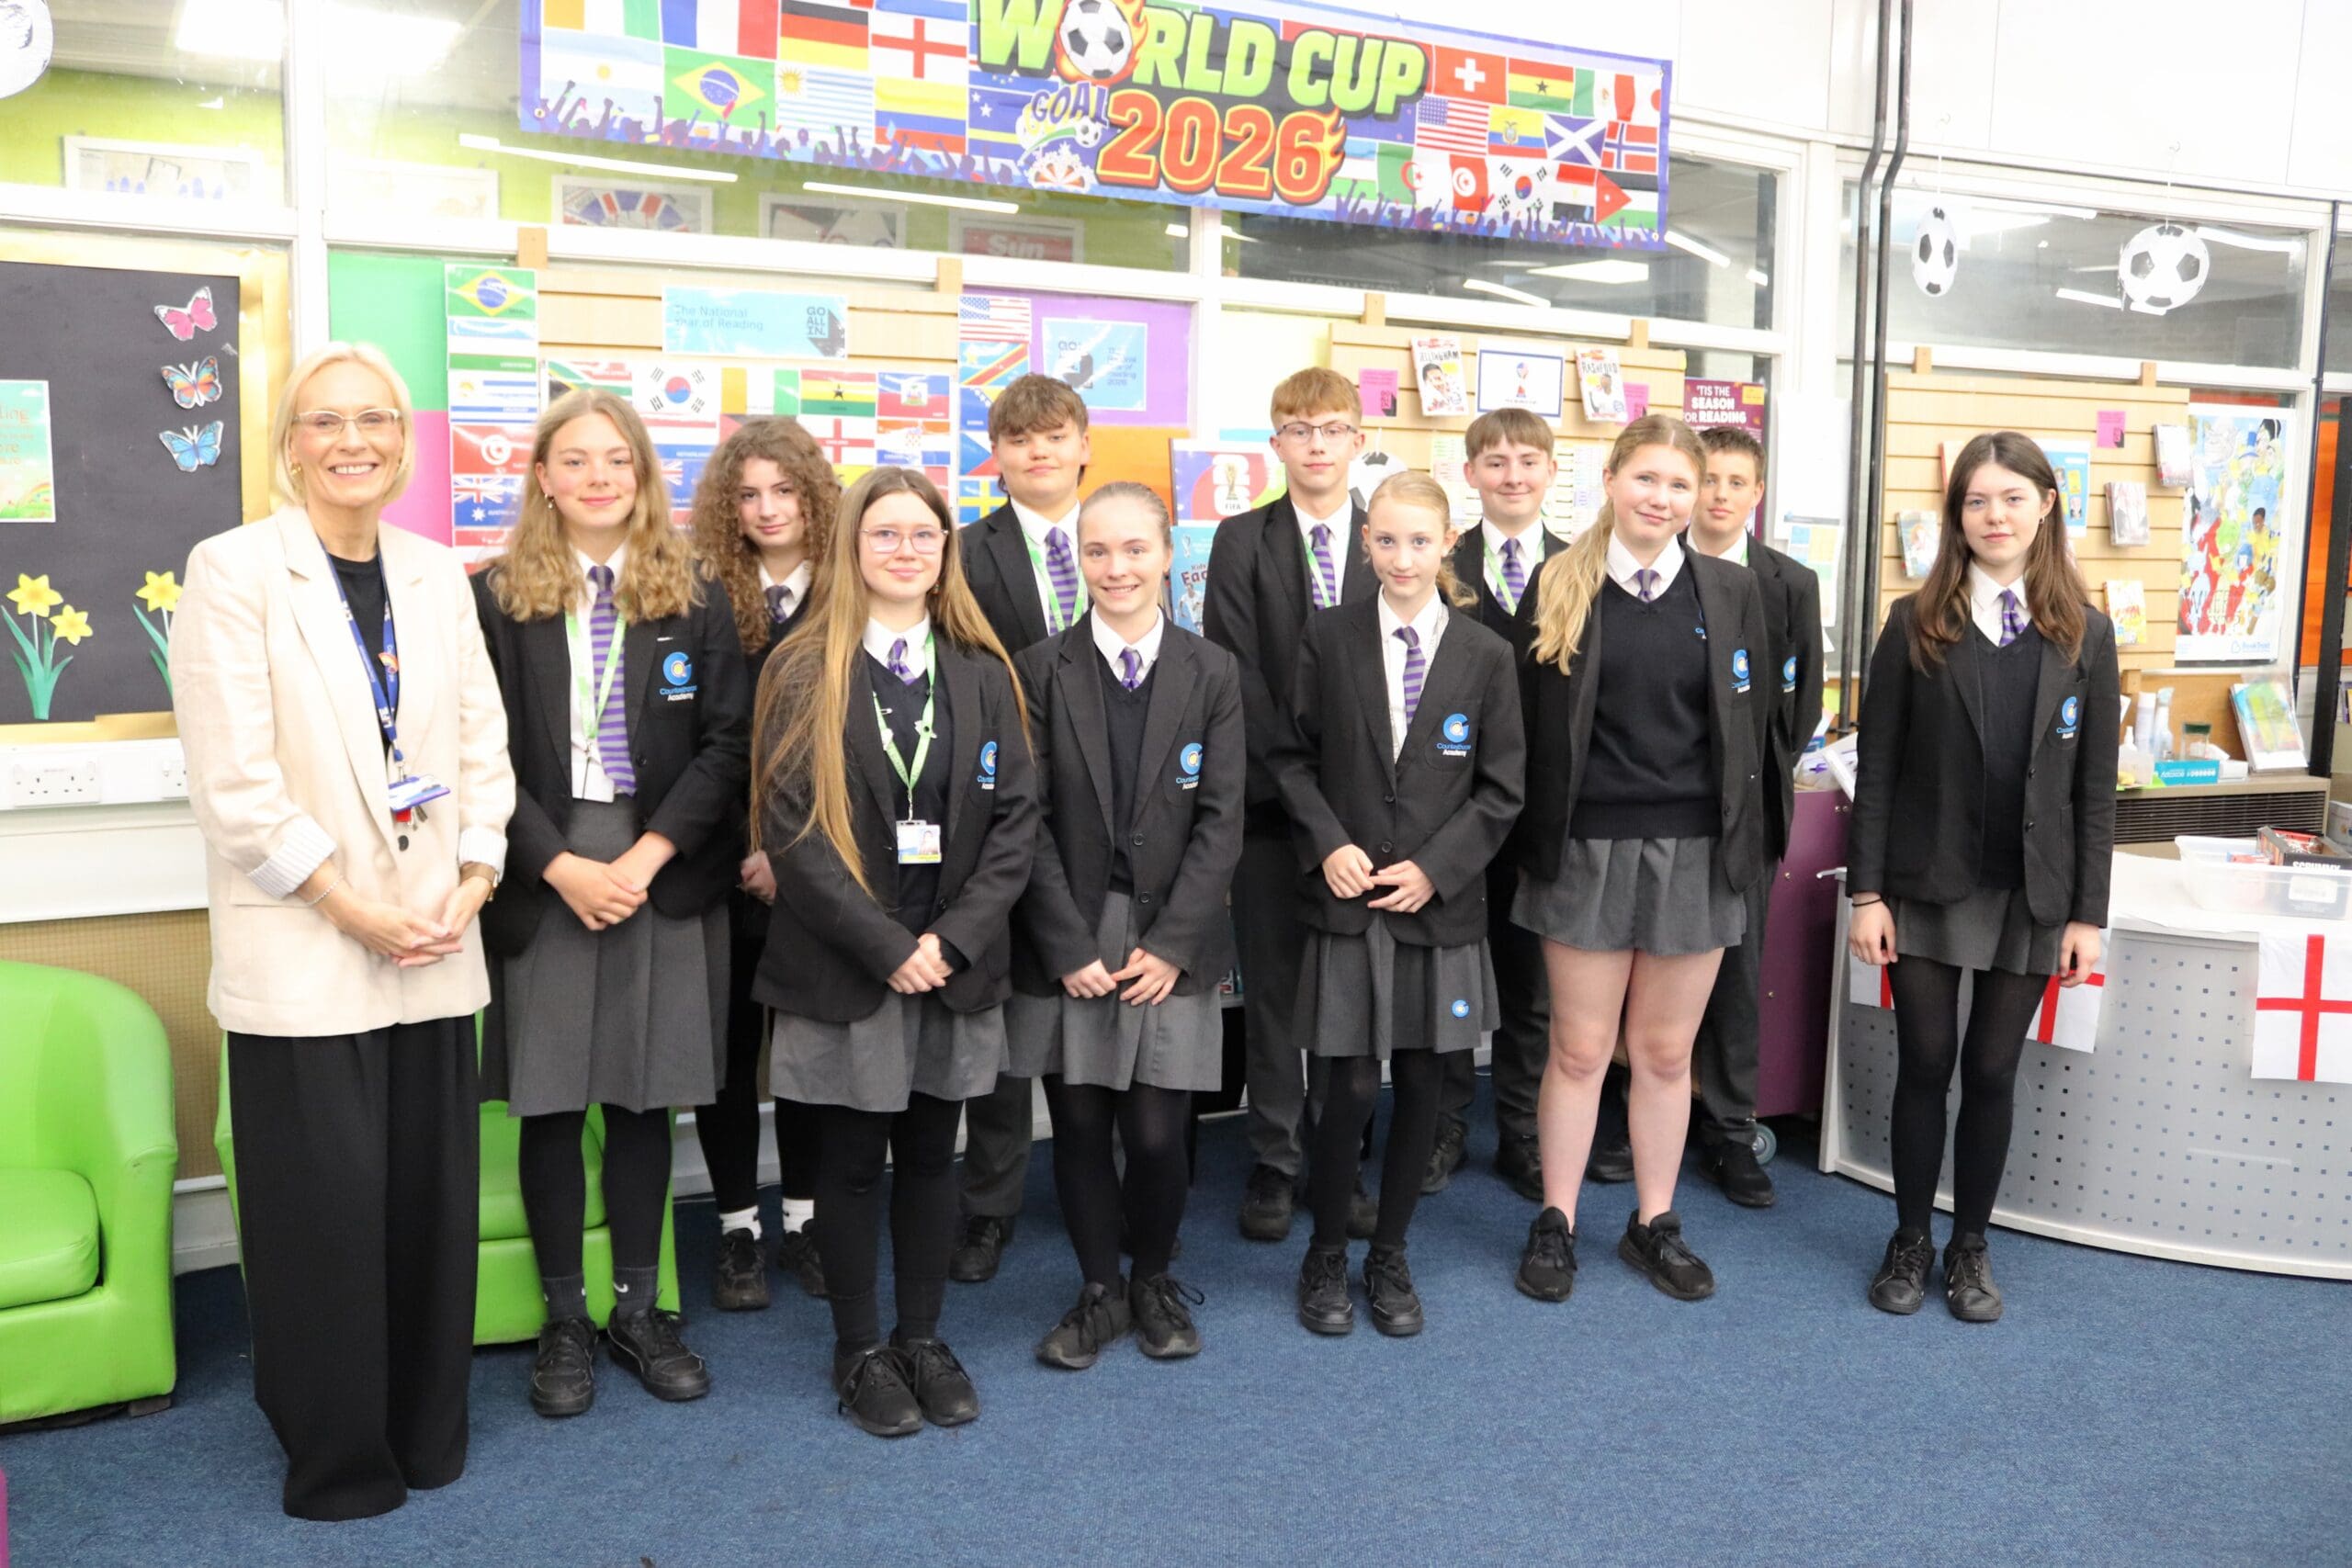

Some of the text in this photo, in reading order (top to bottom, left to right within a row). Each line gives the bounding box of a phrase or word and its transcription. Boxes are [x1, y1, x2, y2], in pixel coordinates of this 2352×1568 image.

[1288, 29, 1425, 115] CUP
[1094, 88, 1339, 204] 2026
[700, 306, 748, 317] National
[806, 306, 826, 316] GO
[702, 317, 715, 328] of
[718, 319, 763, 332] Reading
[806, 316, 826, 325] ALL
[807, 326, 827, 336] IN.
[1696, 385, 1713, 396] 'TIS
[1714, 386, 1730, 397] THE
[1691, 397, 1736, 410] SEASON
[1684, 411, 1747, 424] OR READING
